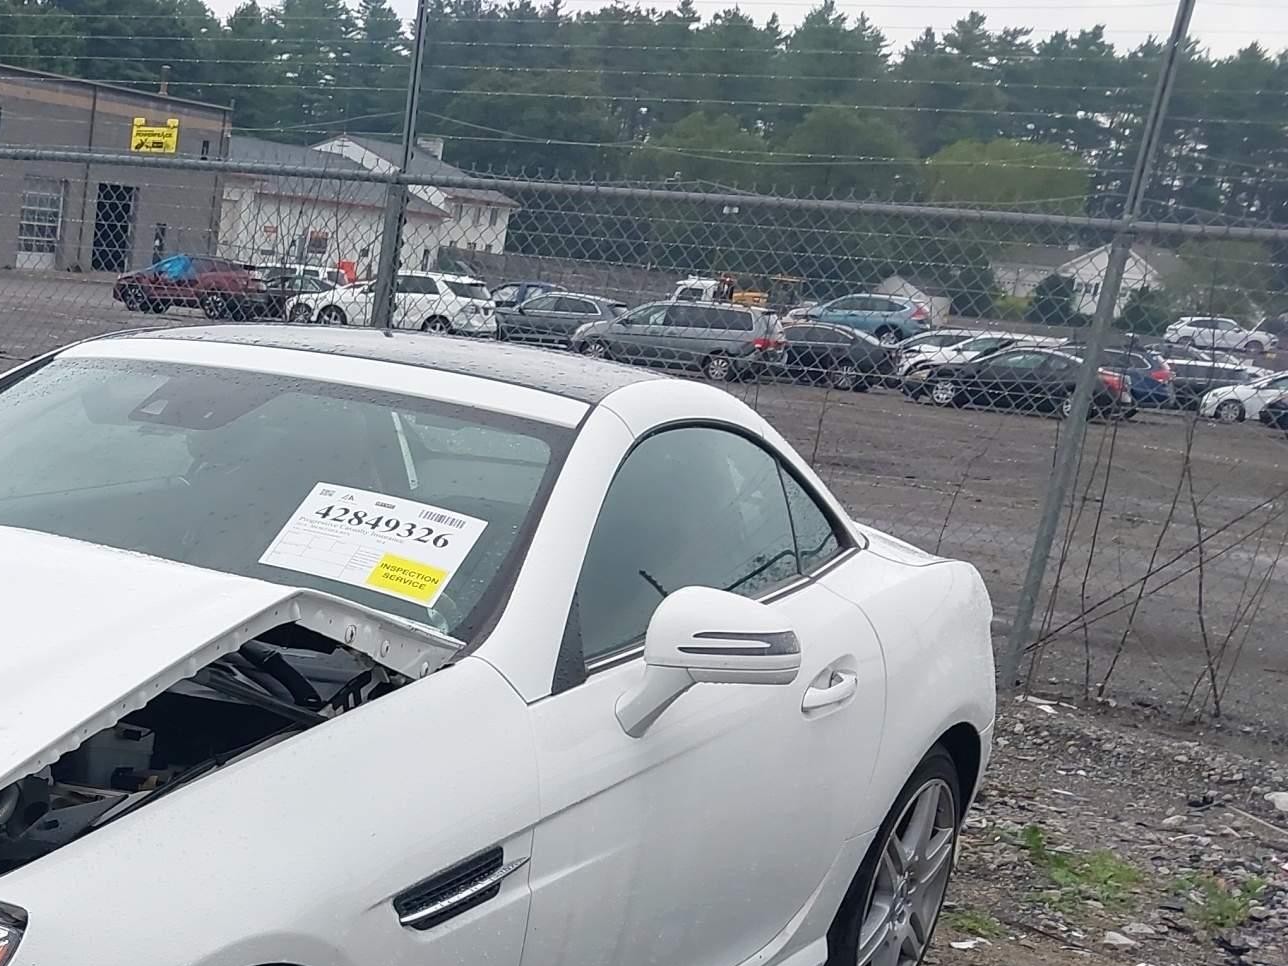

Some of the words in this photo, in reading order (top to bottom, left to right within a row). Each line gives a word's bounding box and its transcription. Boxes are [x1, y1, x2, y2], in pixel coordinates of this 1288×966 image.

[315, 505, 454, 548] 42849326
[380, 562, 440, 585] INSPECTION
[382, 572, 427, 590] SERVICE
